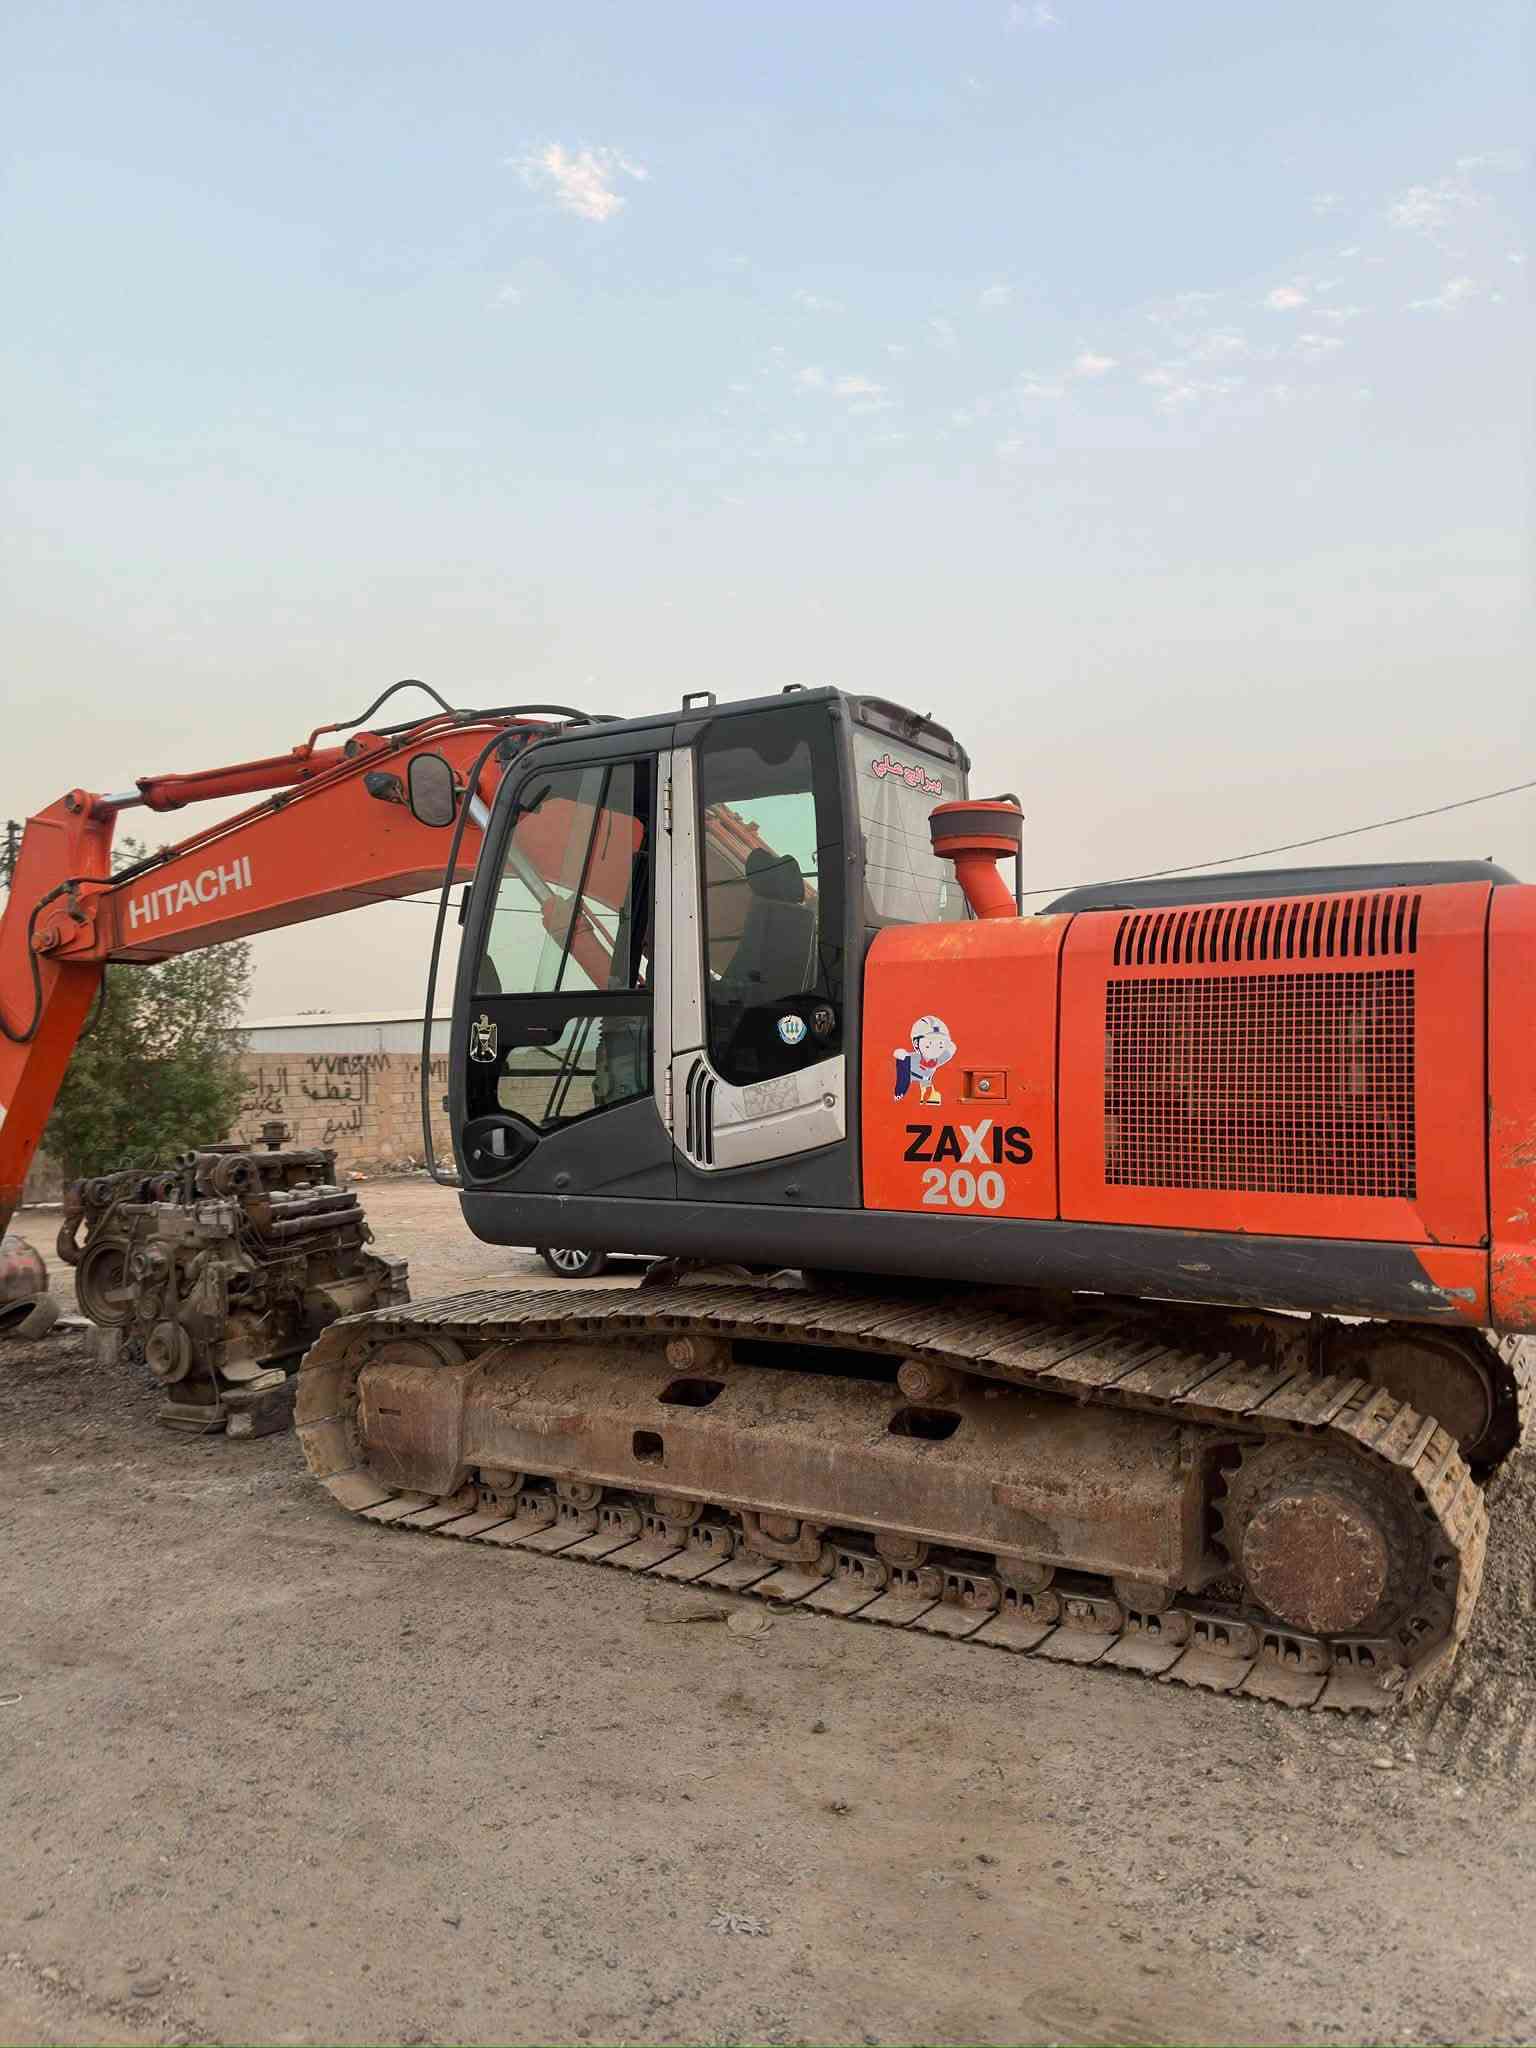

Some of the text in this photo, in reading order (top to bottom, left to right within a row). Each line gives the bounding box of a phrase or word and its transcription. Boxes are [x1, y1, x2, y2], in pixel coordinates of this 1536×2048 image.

[872, 754, 904, 778] علي
[128, 856, 252, 929] HITACHI
[322, 1105, 362, 1144] للبيع
[904, 1119, 1033, 1165] ZAXIS
[922, 1168, 1005, 1209] 200
